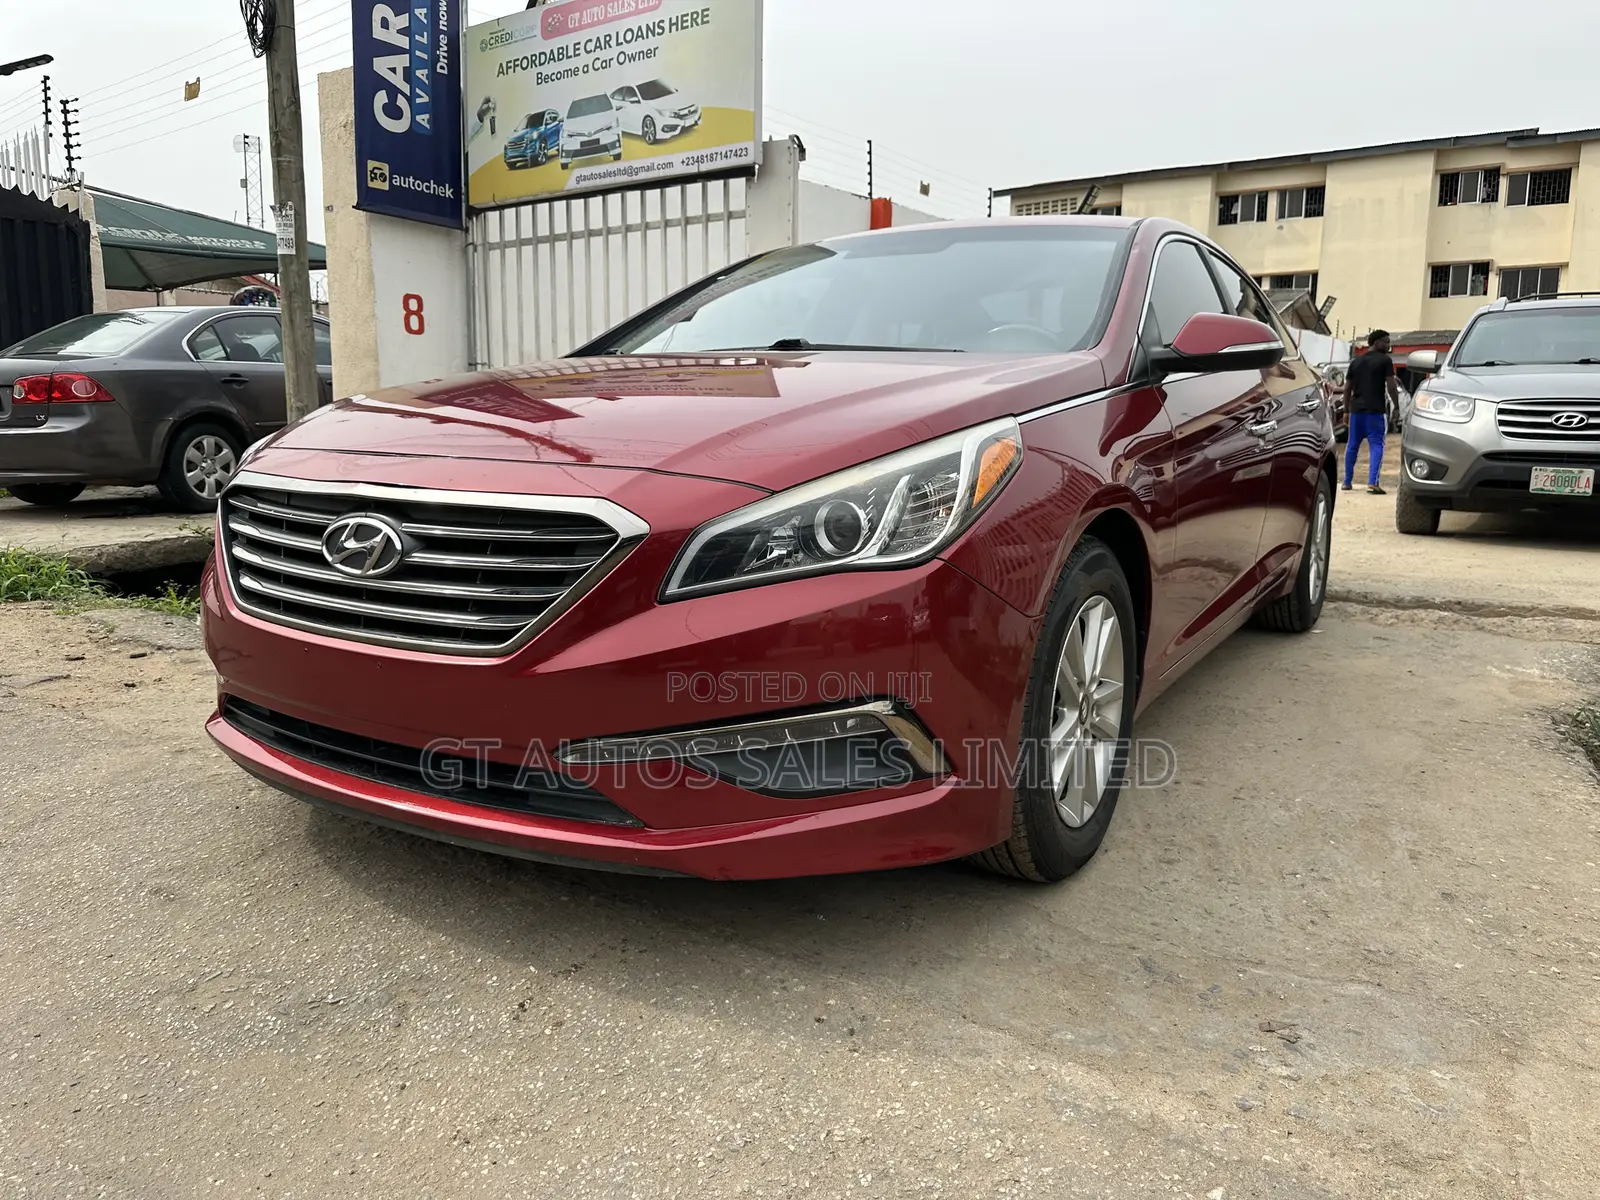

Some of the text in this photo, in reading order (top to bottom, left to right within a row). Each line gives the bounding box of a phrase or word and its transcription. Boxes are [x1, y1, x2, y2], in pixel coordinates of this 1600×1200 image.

[567, 12, 580, 28] GT
[581, 5, 605, 25] AUTO
[607, 0, 636, 17] SALES
[436, 34, 448, 75] Drive
[488, 24, 537, 47] CREDICORP
[496, 41, 581, 78] AFFORDABLE
[583, 33, 613, 54] CAR
[615, 20, 665, 47] LOANS
[668, 8, 711, 33] HERE
[372, 3, 411, 133] CAR
[414, 7, 430, 130] AVAILA
[536, 46, 659, 86] Become a Car Owner
[575, 147, 749, 184] gtautosalesltd@gmail.com +2348187147423
[392, 174, 454, 199] autochek
[402, 293, 425, 336] 8
